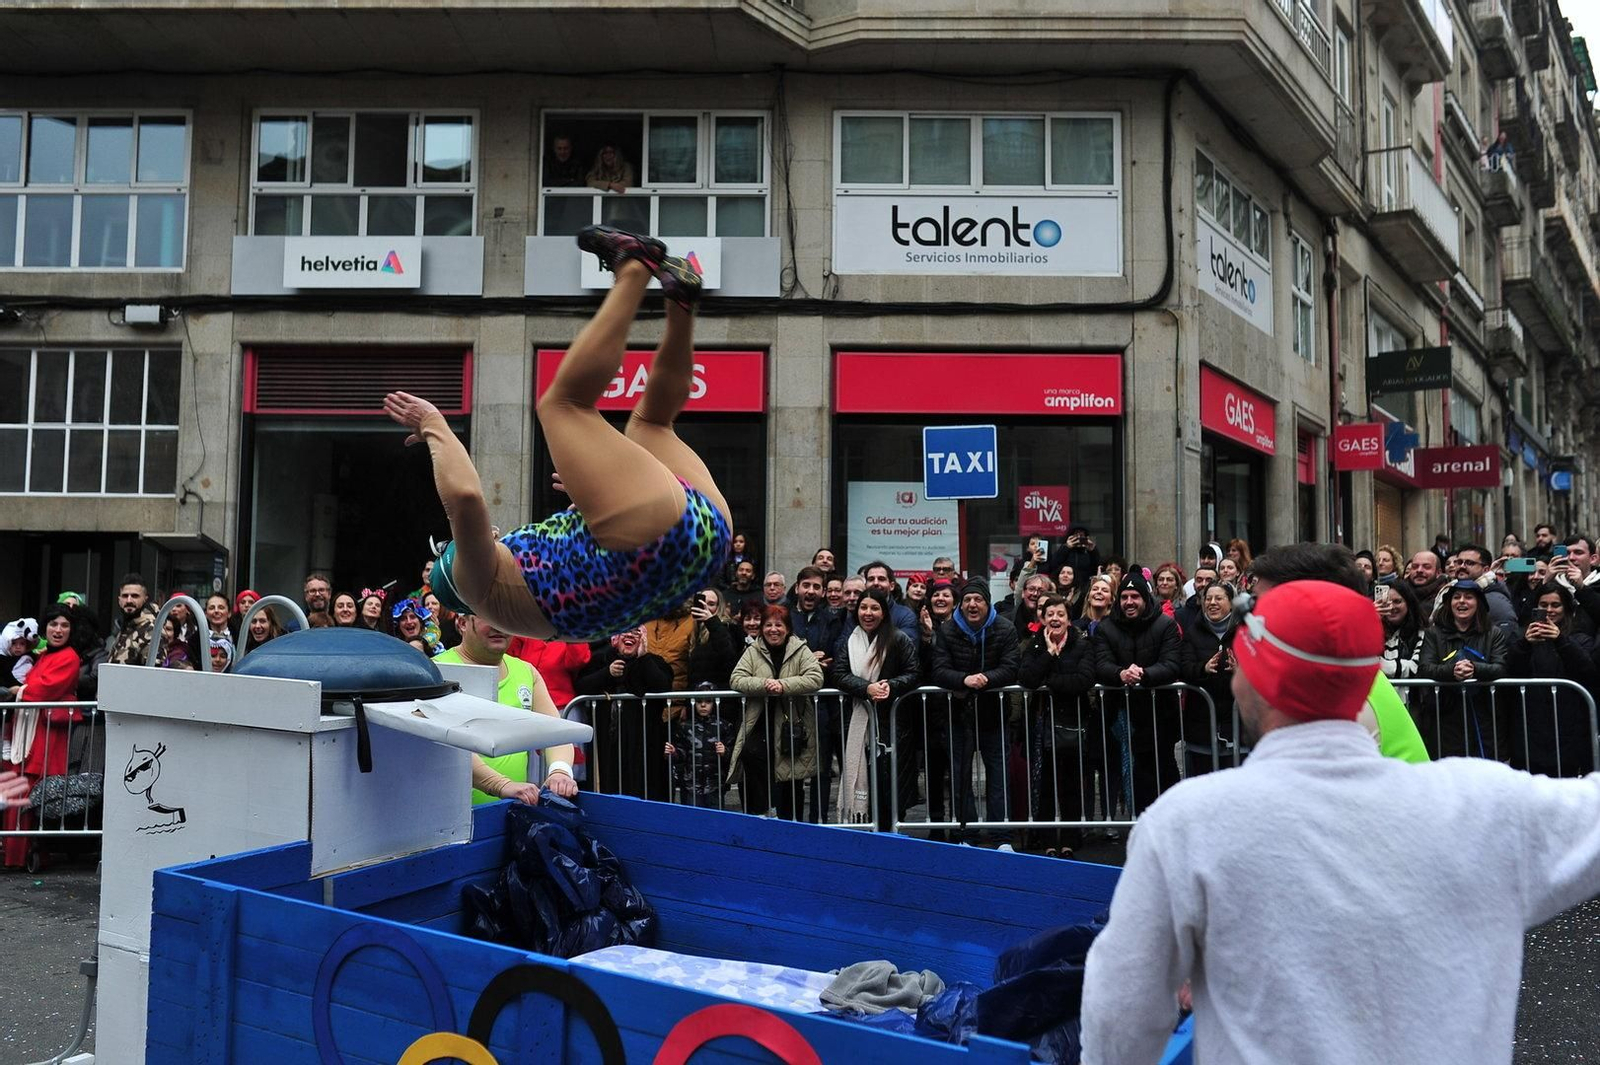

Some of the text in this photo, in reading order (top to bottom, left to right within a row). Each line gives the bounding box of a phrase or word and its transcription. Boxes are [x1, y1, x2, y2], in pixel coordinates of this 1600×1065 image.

[301, 255, 378, 271] helvetia
[905, 252, 1049, 264] Servicios Inmobiliarios
[1044, 393, 1115, 411] amplifon
[1224, 392, 1255, 435] GAES
[1338, 437, 1379, 452] GAES
[927, 451, 994, 474] TAXI
[1432, 457, 1491, 474] arenal
[1024, 496, 1048, 509] SIN
[865, 516, 948, 526] Cuidar tu audición
[1039, 509, 1063, 522] IVA
[871, 527, 943, 538] es tu mejor plan
